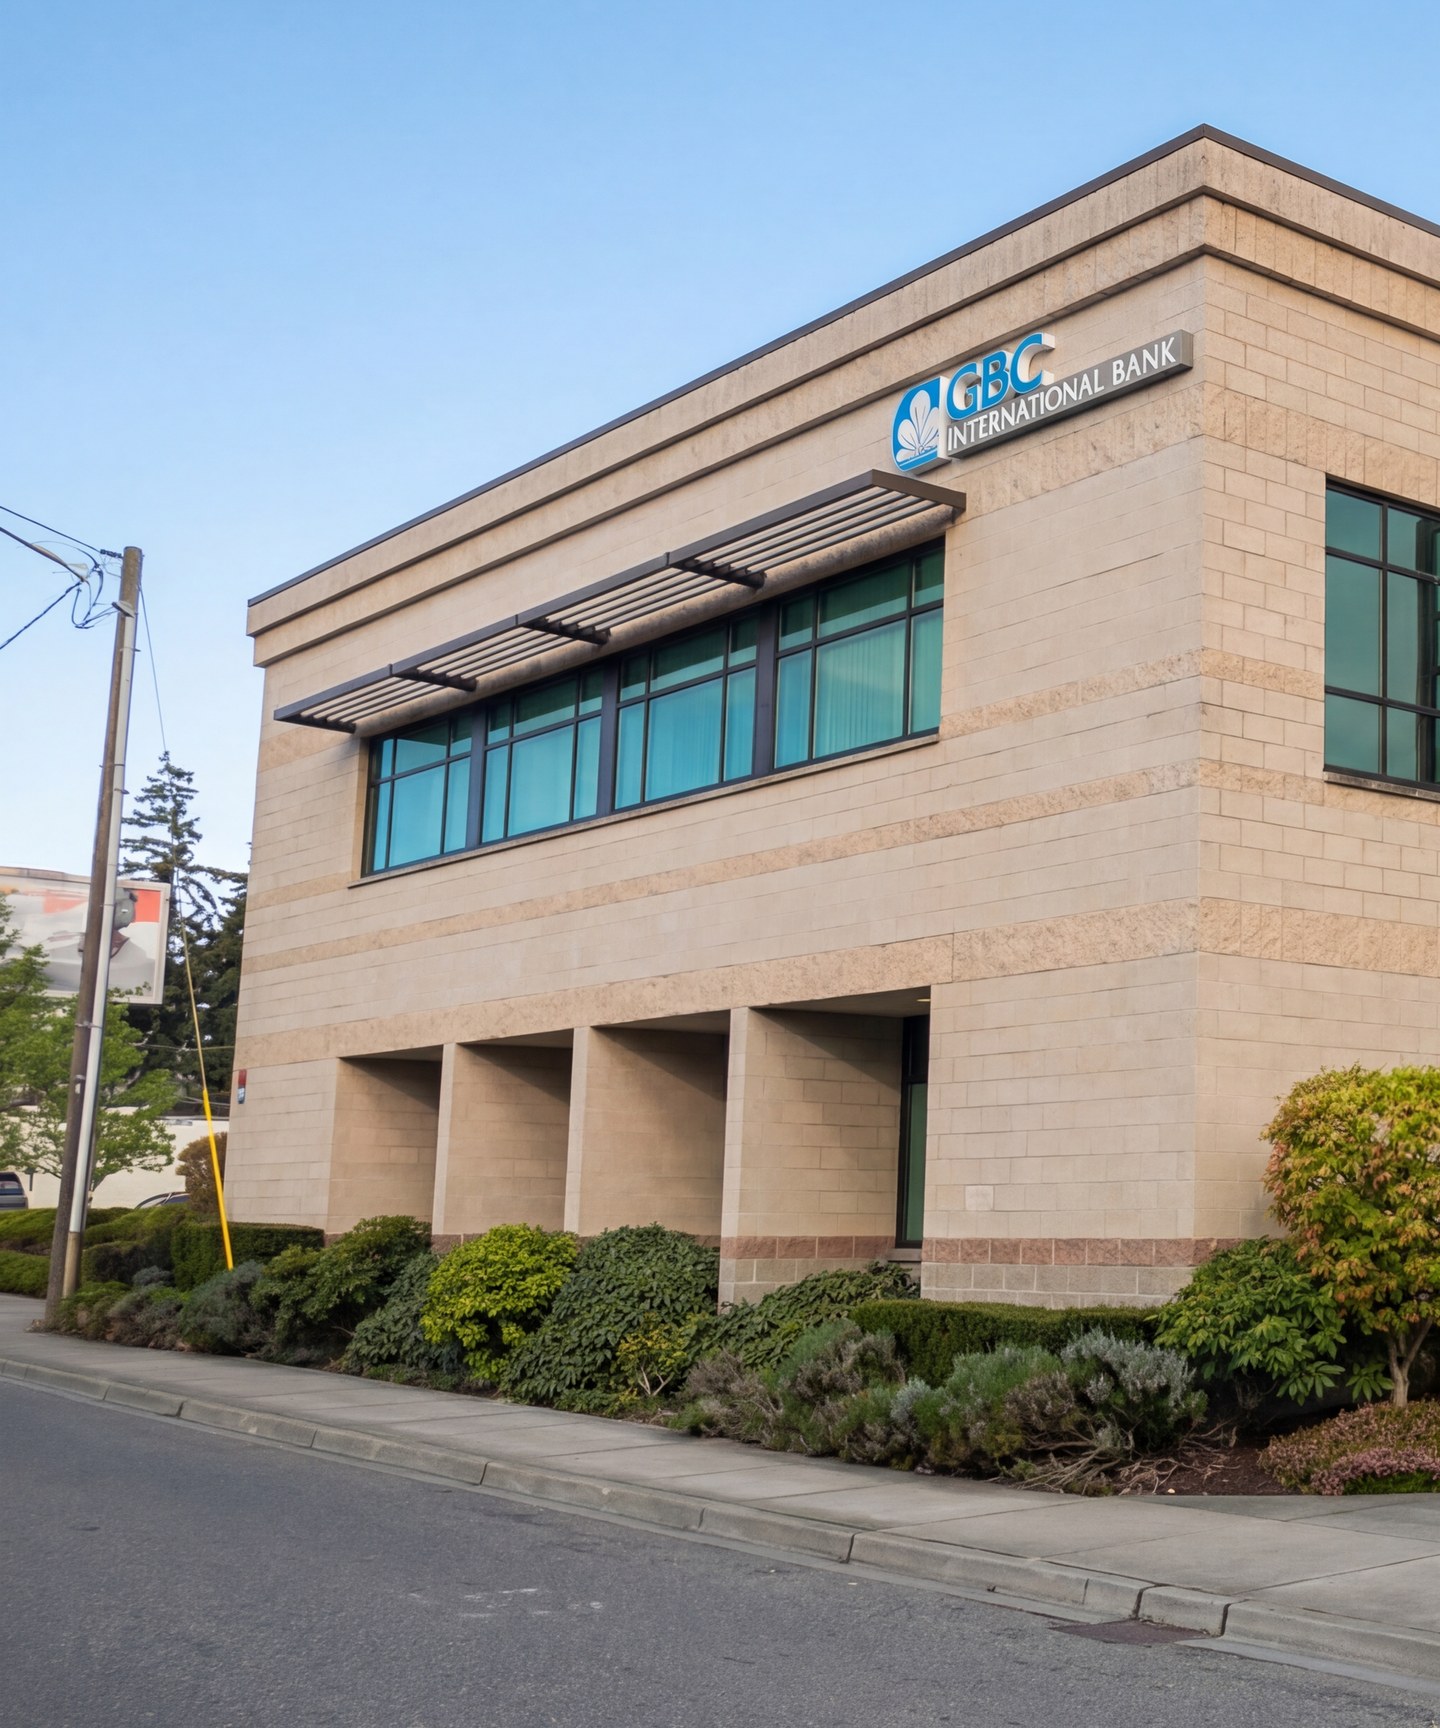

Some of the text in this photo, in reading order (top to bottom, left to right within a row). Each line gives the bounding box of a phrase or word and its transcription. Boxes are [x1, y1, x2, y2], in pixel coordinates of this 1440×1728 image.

[946, 332, 1050, 420] GBC
[948, 337, 1177, 450] INTERNATIONAL BANK
